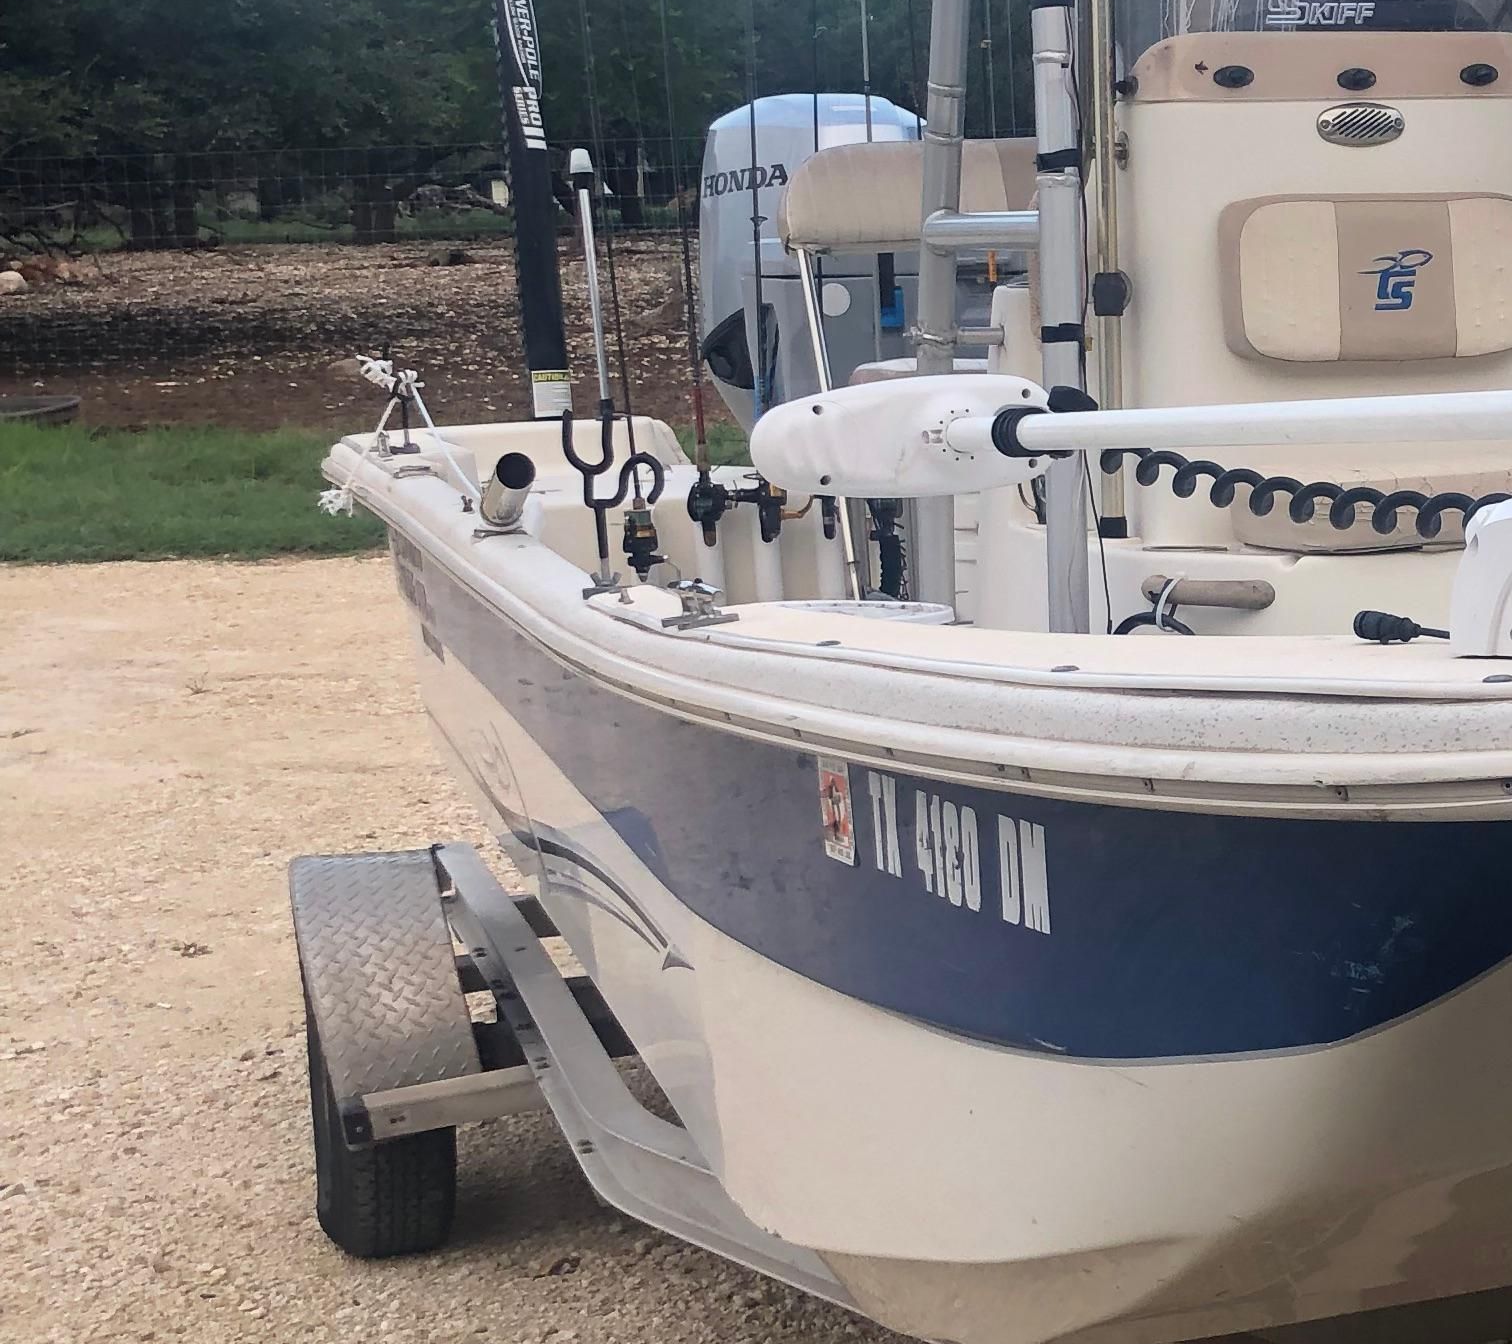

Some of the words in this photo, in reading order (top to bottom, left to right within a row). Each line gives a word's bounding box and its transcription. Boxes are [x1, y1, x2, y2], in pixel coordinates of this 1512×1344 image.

[521, 86, 543, 126] PRO
[703, 163, 789, 198] HONDA
[868, 771, 903, 879] TX
[998, 813, 1051, 935] DM
